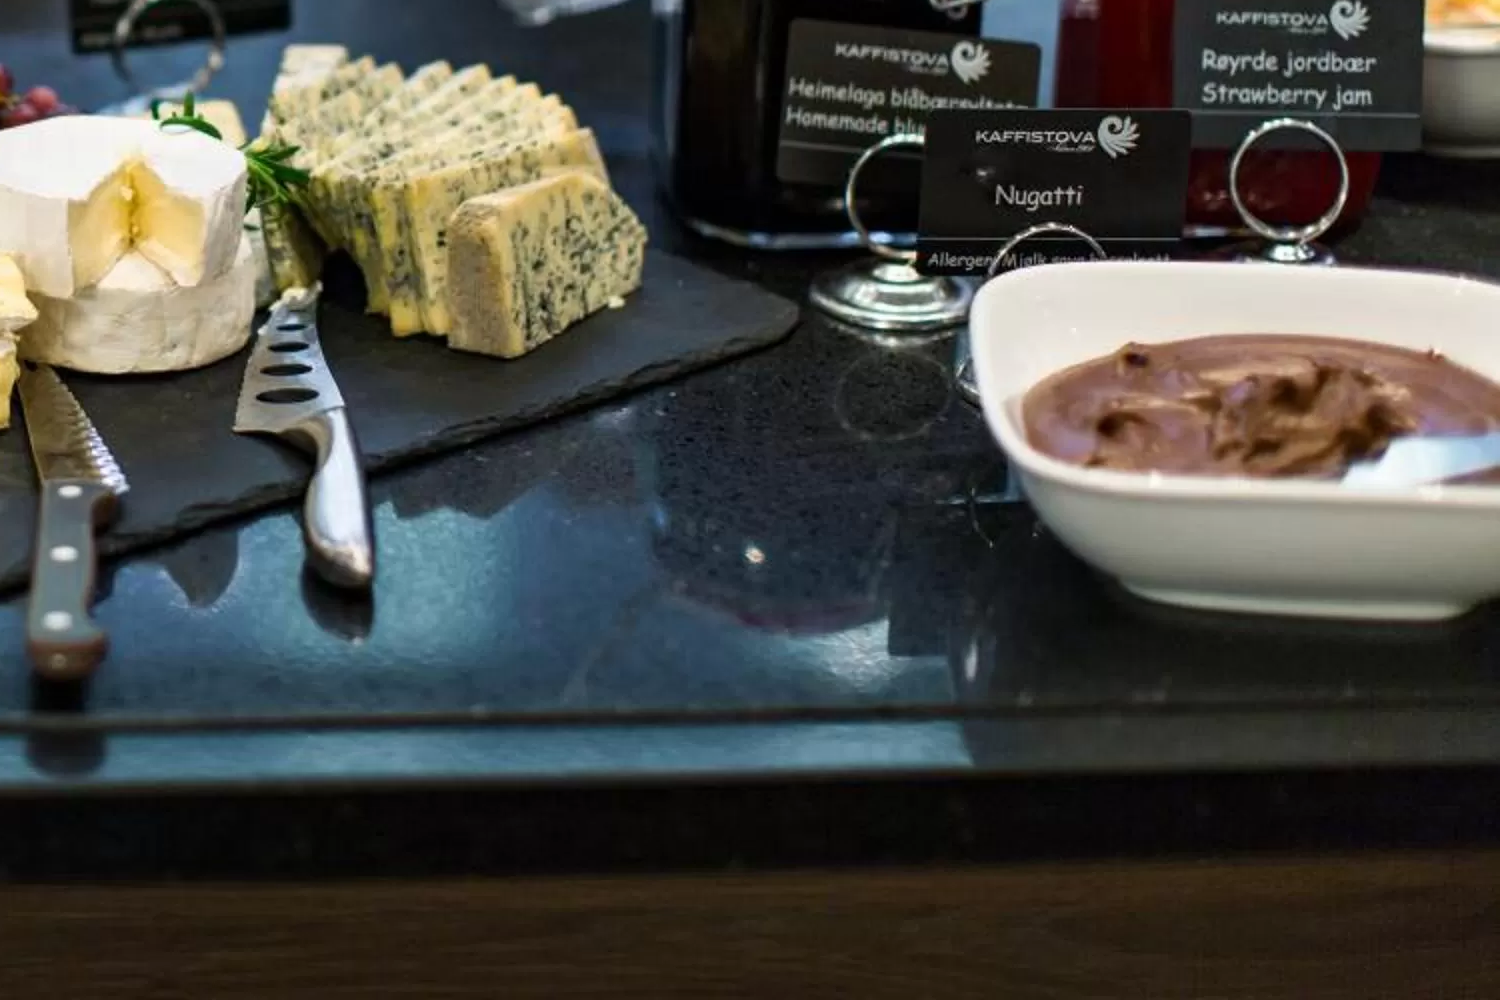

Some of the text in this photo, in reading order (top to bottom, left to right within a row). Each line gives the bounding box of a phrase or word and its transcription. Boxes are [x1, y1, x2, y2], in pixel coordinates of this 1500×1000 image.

[1216, 11, 1329, 26] KAFFISTOVA
[834, 41, 950, 66] KAFFISTOVA
[1202, 49, 1377, 78] Røyrde jordbær
[788, 76, 886, 109] Heimelaga
[1202, 82, 1373, 111] Strawberry jam
[785, 104, 889, 134] Homemade
[975, 131, 1096, 143] KAFFISTOVA
[994, 183, 1085, 212] Nugatti
